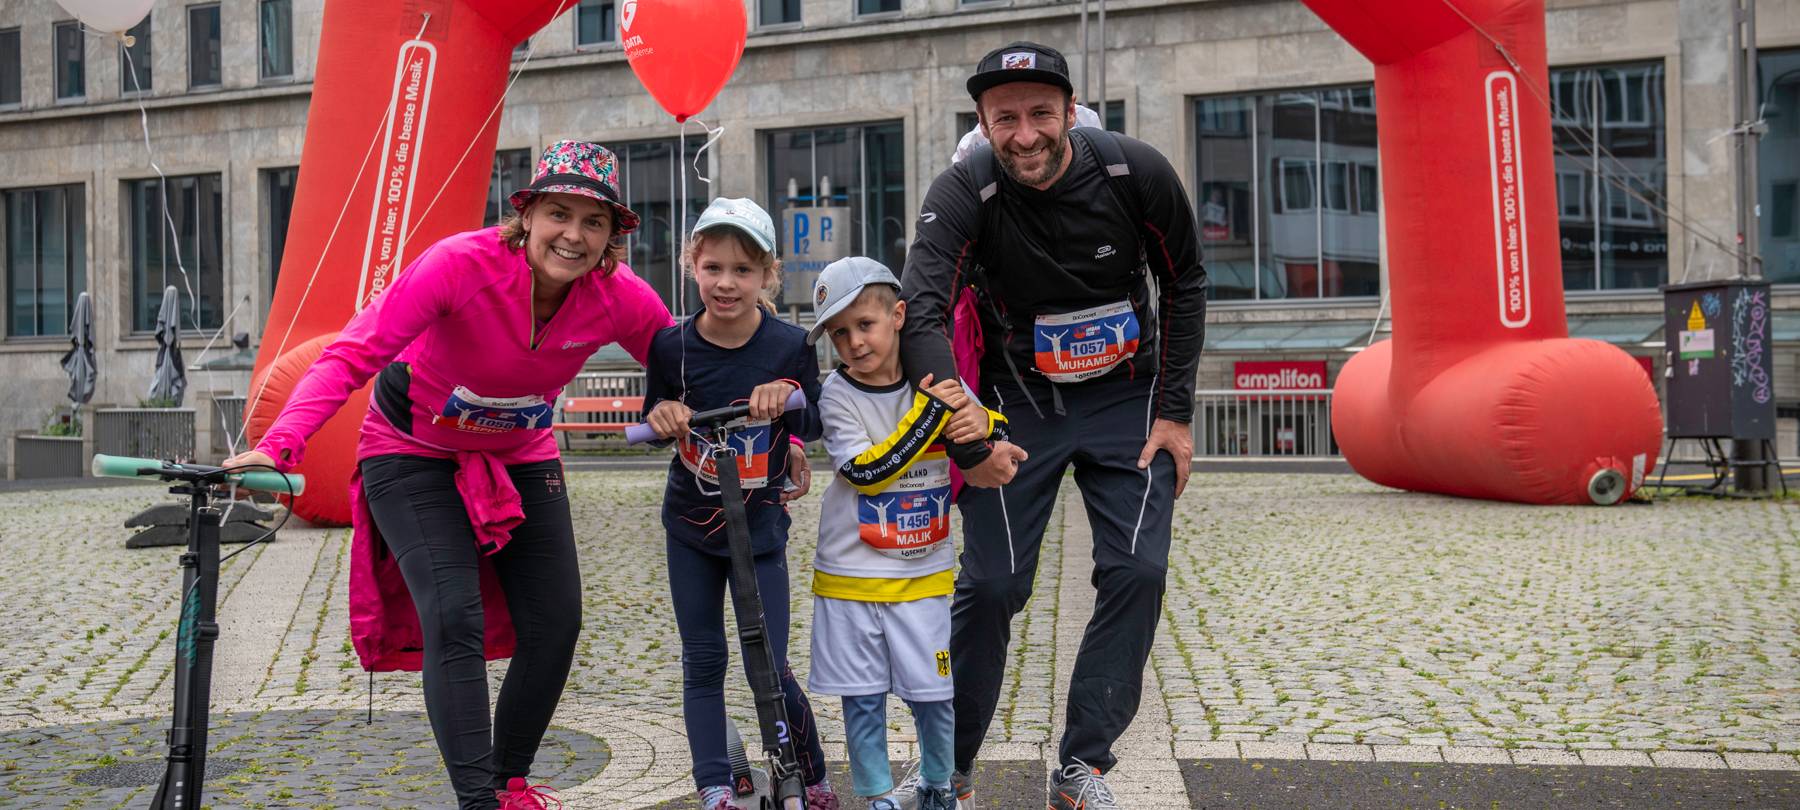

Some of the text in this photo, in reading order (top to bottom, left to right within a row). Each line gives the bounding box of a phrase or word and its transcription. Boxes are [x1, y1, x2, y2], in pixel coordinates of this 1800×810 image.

[626, 35, 644, 50] DATA
[405, 58, 424, 101] Musik.
[398, 103, 416, 140] beste
[395, 142, 409, 162] die
[387, 164, 406, 205] 100%
[1497, 86, 1521, 313] 100% von hier. 100% die beste Musik.
[382, 206, 399, 235] hier.
[380, 237, 393, 261] von
[1071, 341, 1105, 356] 1057
[1058, 353, 1118, 370] MUHAMED
[1237, 368, 1322, 390] amplifon
[478, 417, 514, 429] 1058
[898, 468, 928, 480] HLAND
[898, 513, 929, 529] 1456
[896, 531, 931, 545] MALIK
